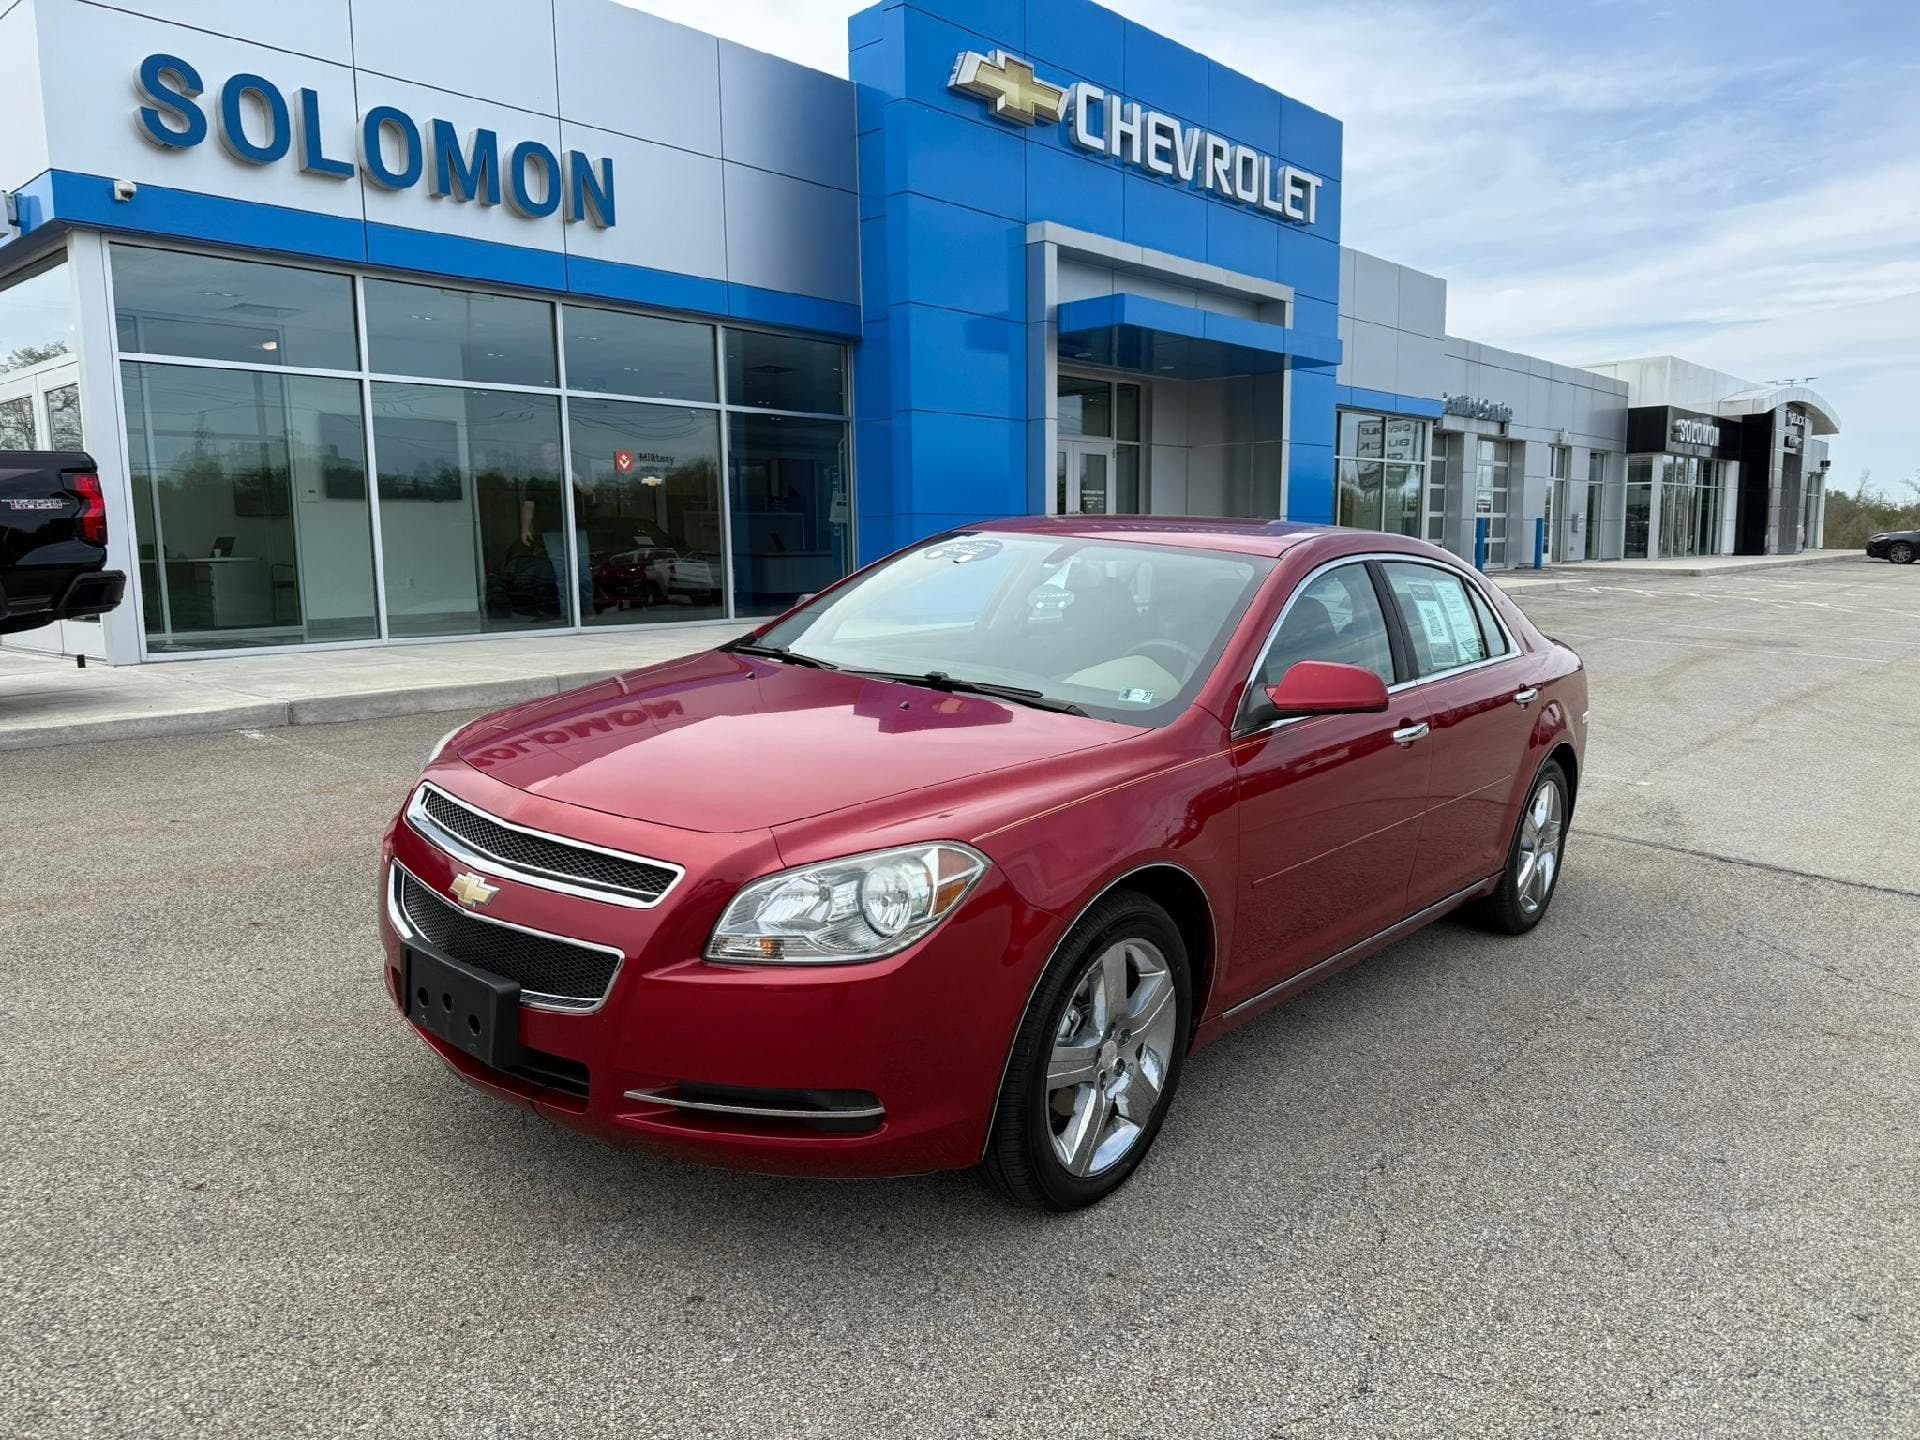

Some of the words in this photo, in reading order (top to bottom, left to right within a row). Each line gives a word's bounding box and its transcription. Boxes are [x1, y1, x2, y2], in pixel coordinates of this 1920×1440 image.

[134, 53, 616, 229] SOLOMON
[1070, 82, 1323, 225] CHEVROLET
[639, 453, 675, 465] Military
[1679, 418, 1720, 447] SOLOMON
